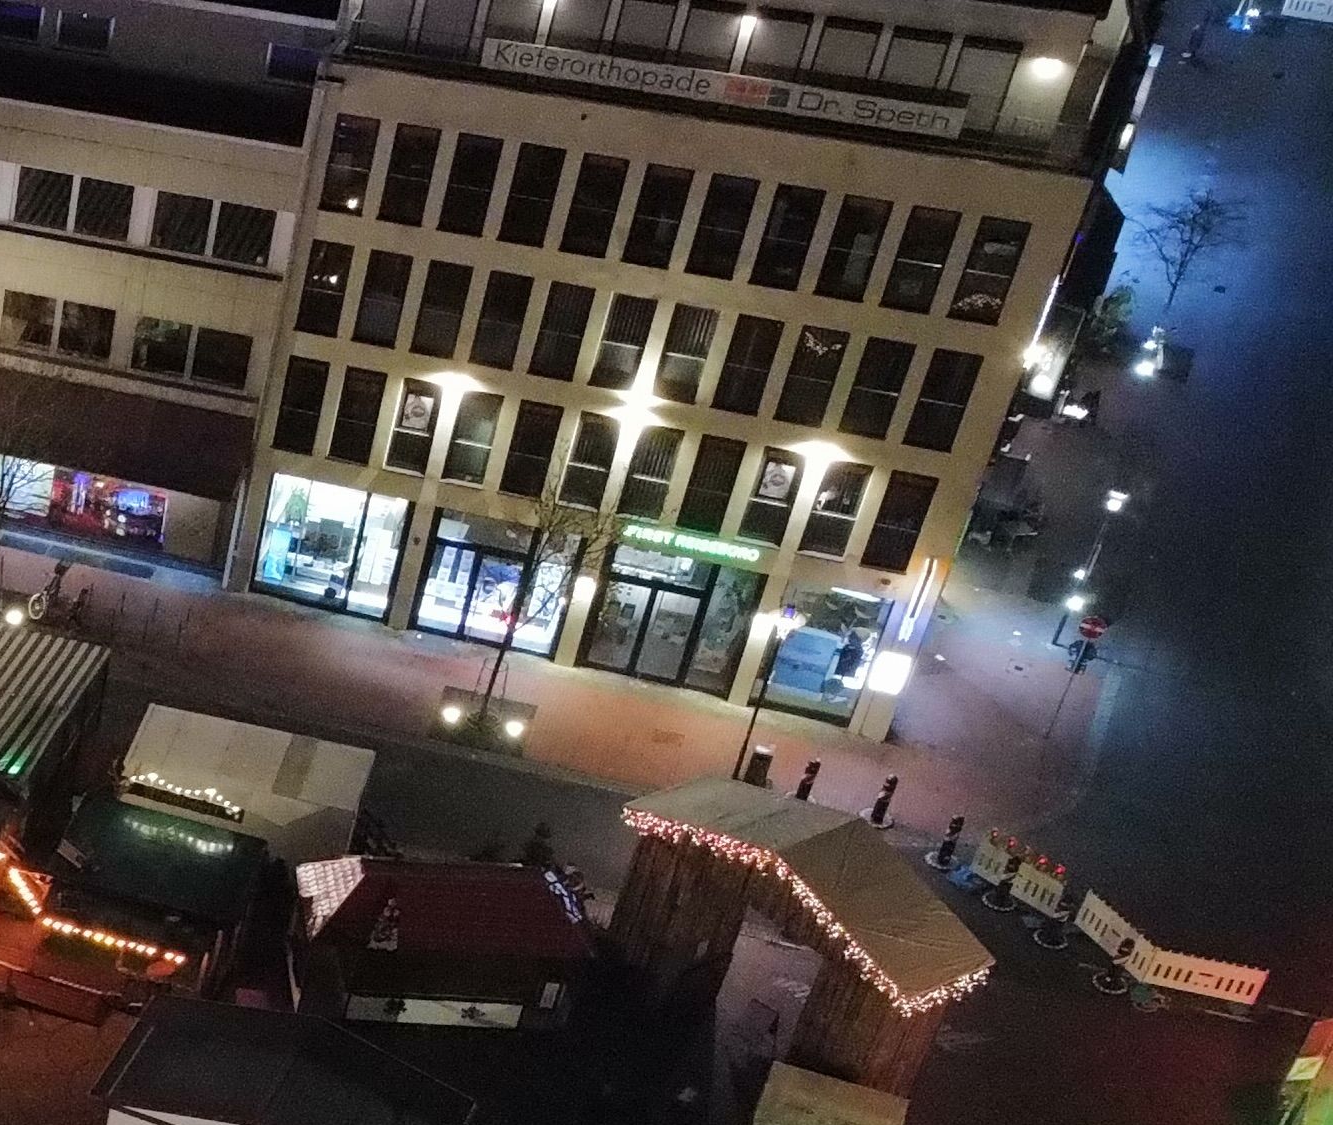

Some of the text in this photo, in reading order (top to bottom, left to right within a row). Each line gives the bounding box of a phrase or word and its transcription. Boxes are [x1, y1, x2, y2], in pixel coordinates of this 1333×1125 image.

[493, 43, 951, 131] Kieferorthopäde Dr. Speth
